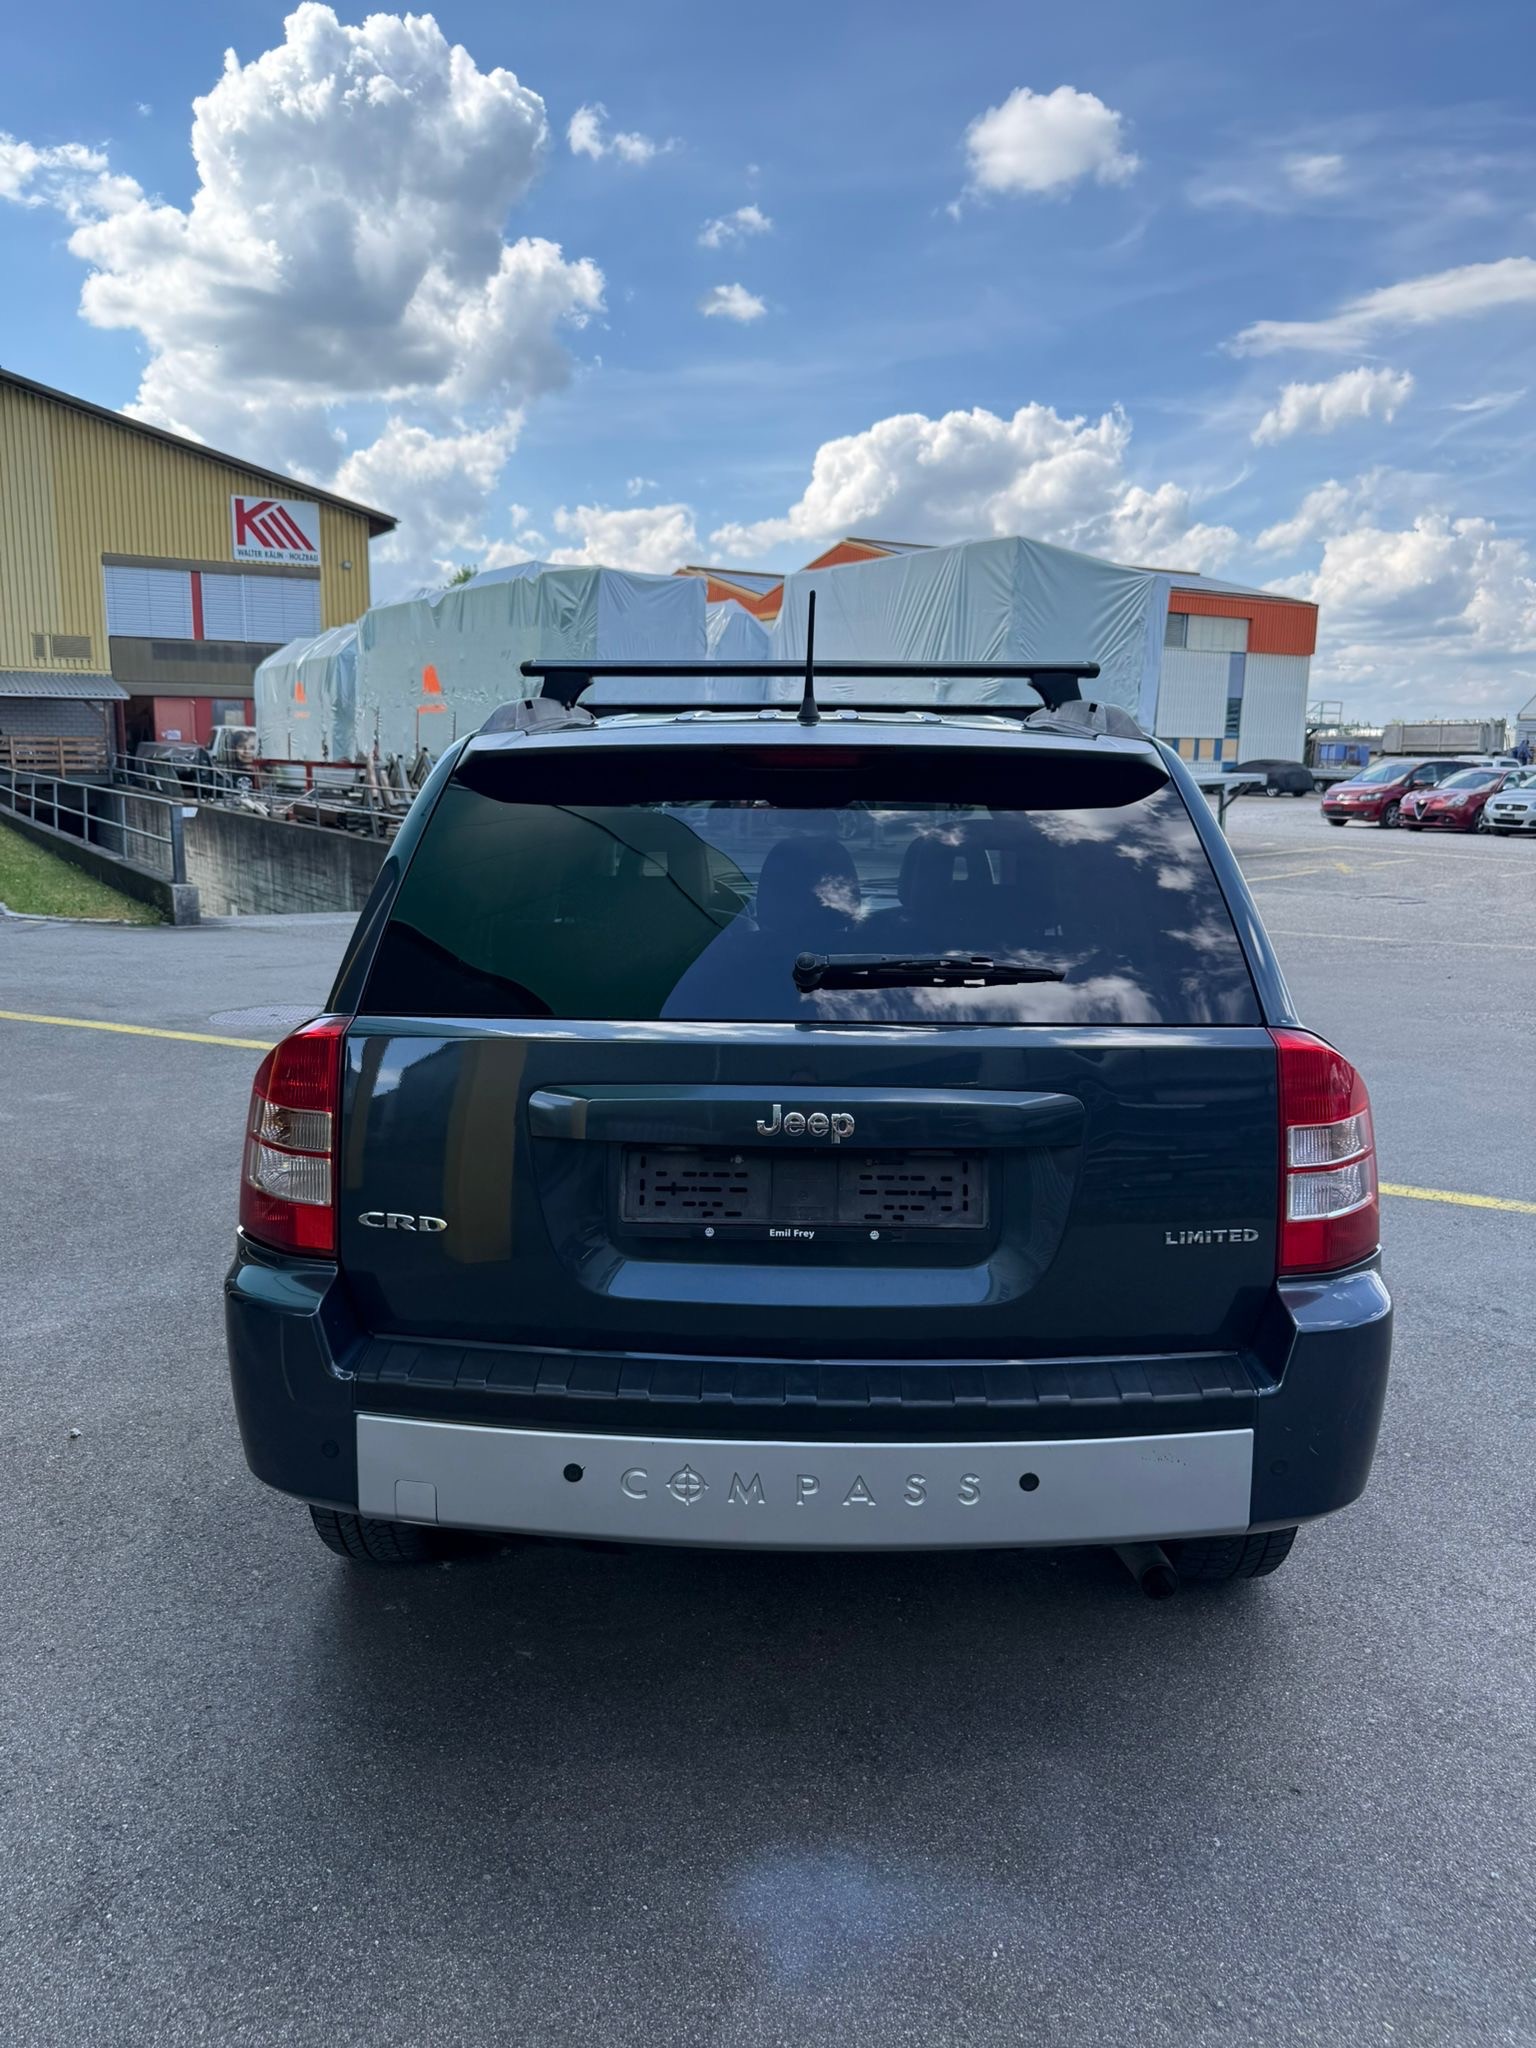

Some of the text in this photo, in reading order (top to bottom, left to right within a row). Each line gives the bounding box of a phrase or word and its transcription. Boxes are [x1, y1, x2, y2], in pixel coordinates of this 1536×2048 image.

[237, 548, 262, 558] WALTER
[289, 551, 319, 561] HOLZBAU
[756, 1104, 855, 1144] Jeep
[358, 1211, 448, 1232] CRD
[769, 1228, 815, 1240] Emil Frey
[620, 1463, 981, 1507] COMPASS
